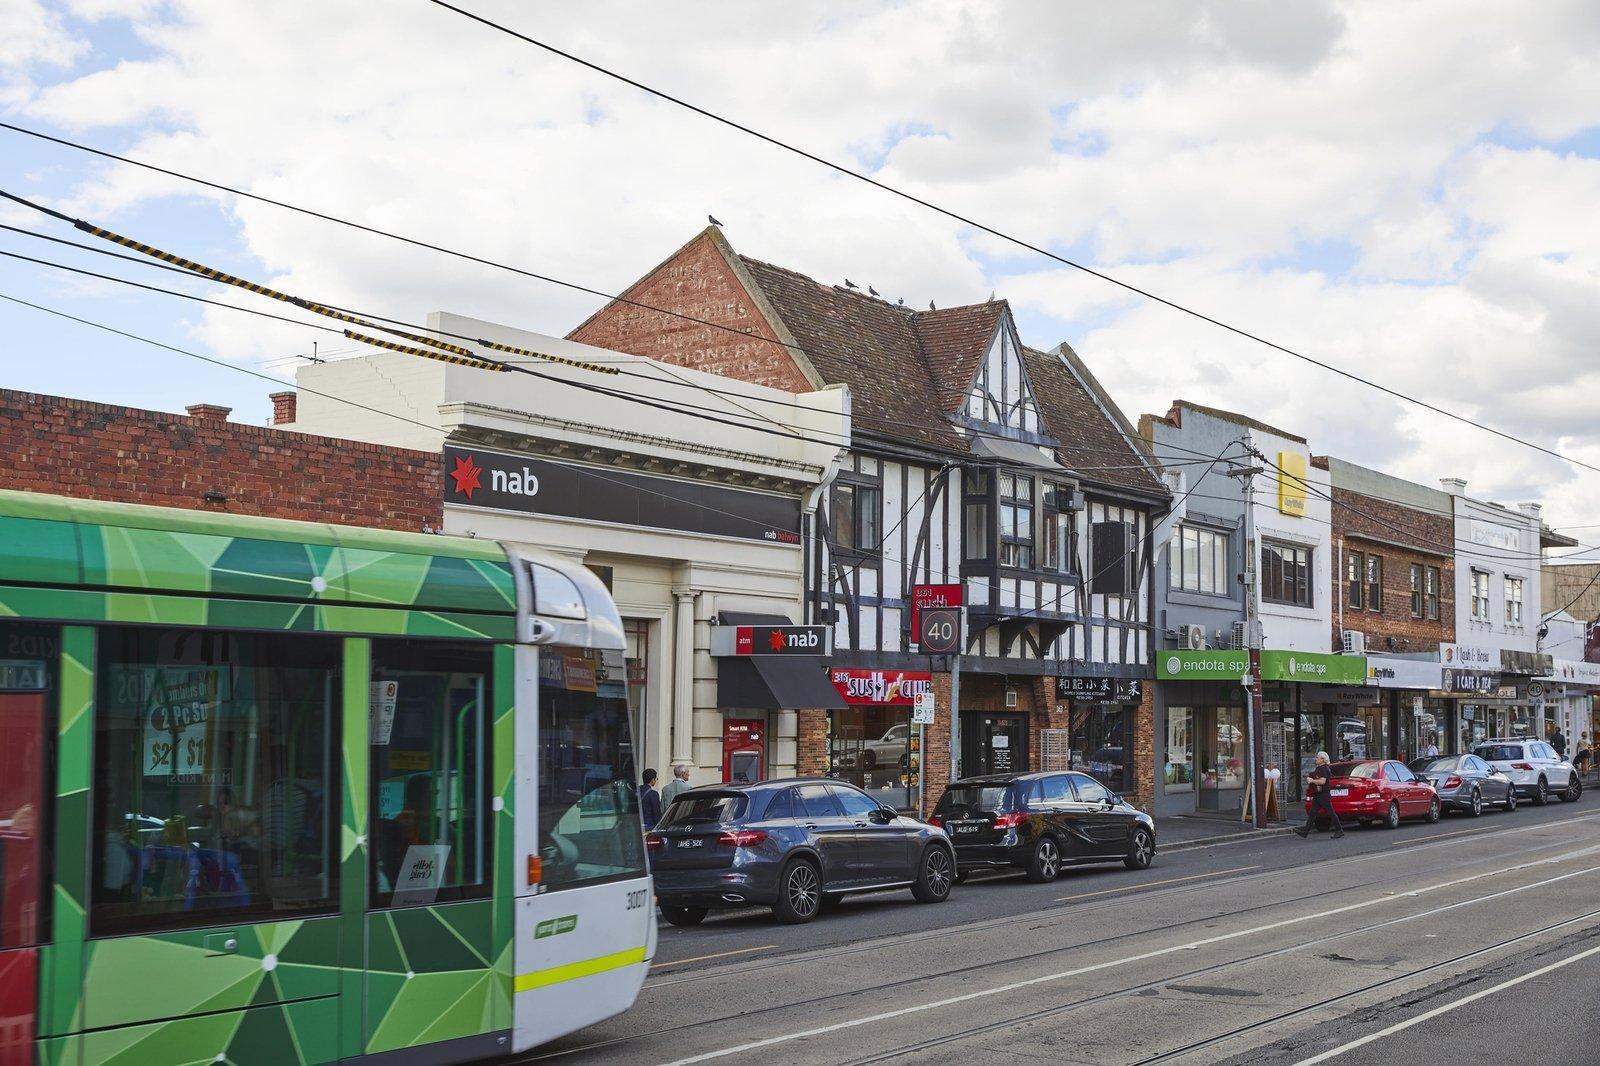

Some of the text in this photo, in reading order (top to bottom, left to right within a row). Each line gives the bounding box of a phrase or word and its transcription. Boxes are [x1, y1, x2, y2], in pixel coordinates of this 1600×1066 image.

[491, 467, 539, 496] nab
[764, 530, 799, 543] nab balwyn
[788, 630, 819, 647] nab
[928, 622, 952, 640] 40
[1183, 660, 1250, 672] endota spa
[1296, 661, 1327, 676] endota spa
[834, 672, 849, 683] 361
[847, 672, 887, 701] SUSHI
[1460, 676, 1475, 689] CAFE
[1530, 685, 1541, 693] 40
